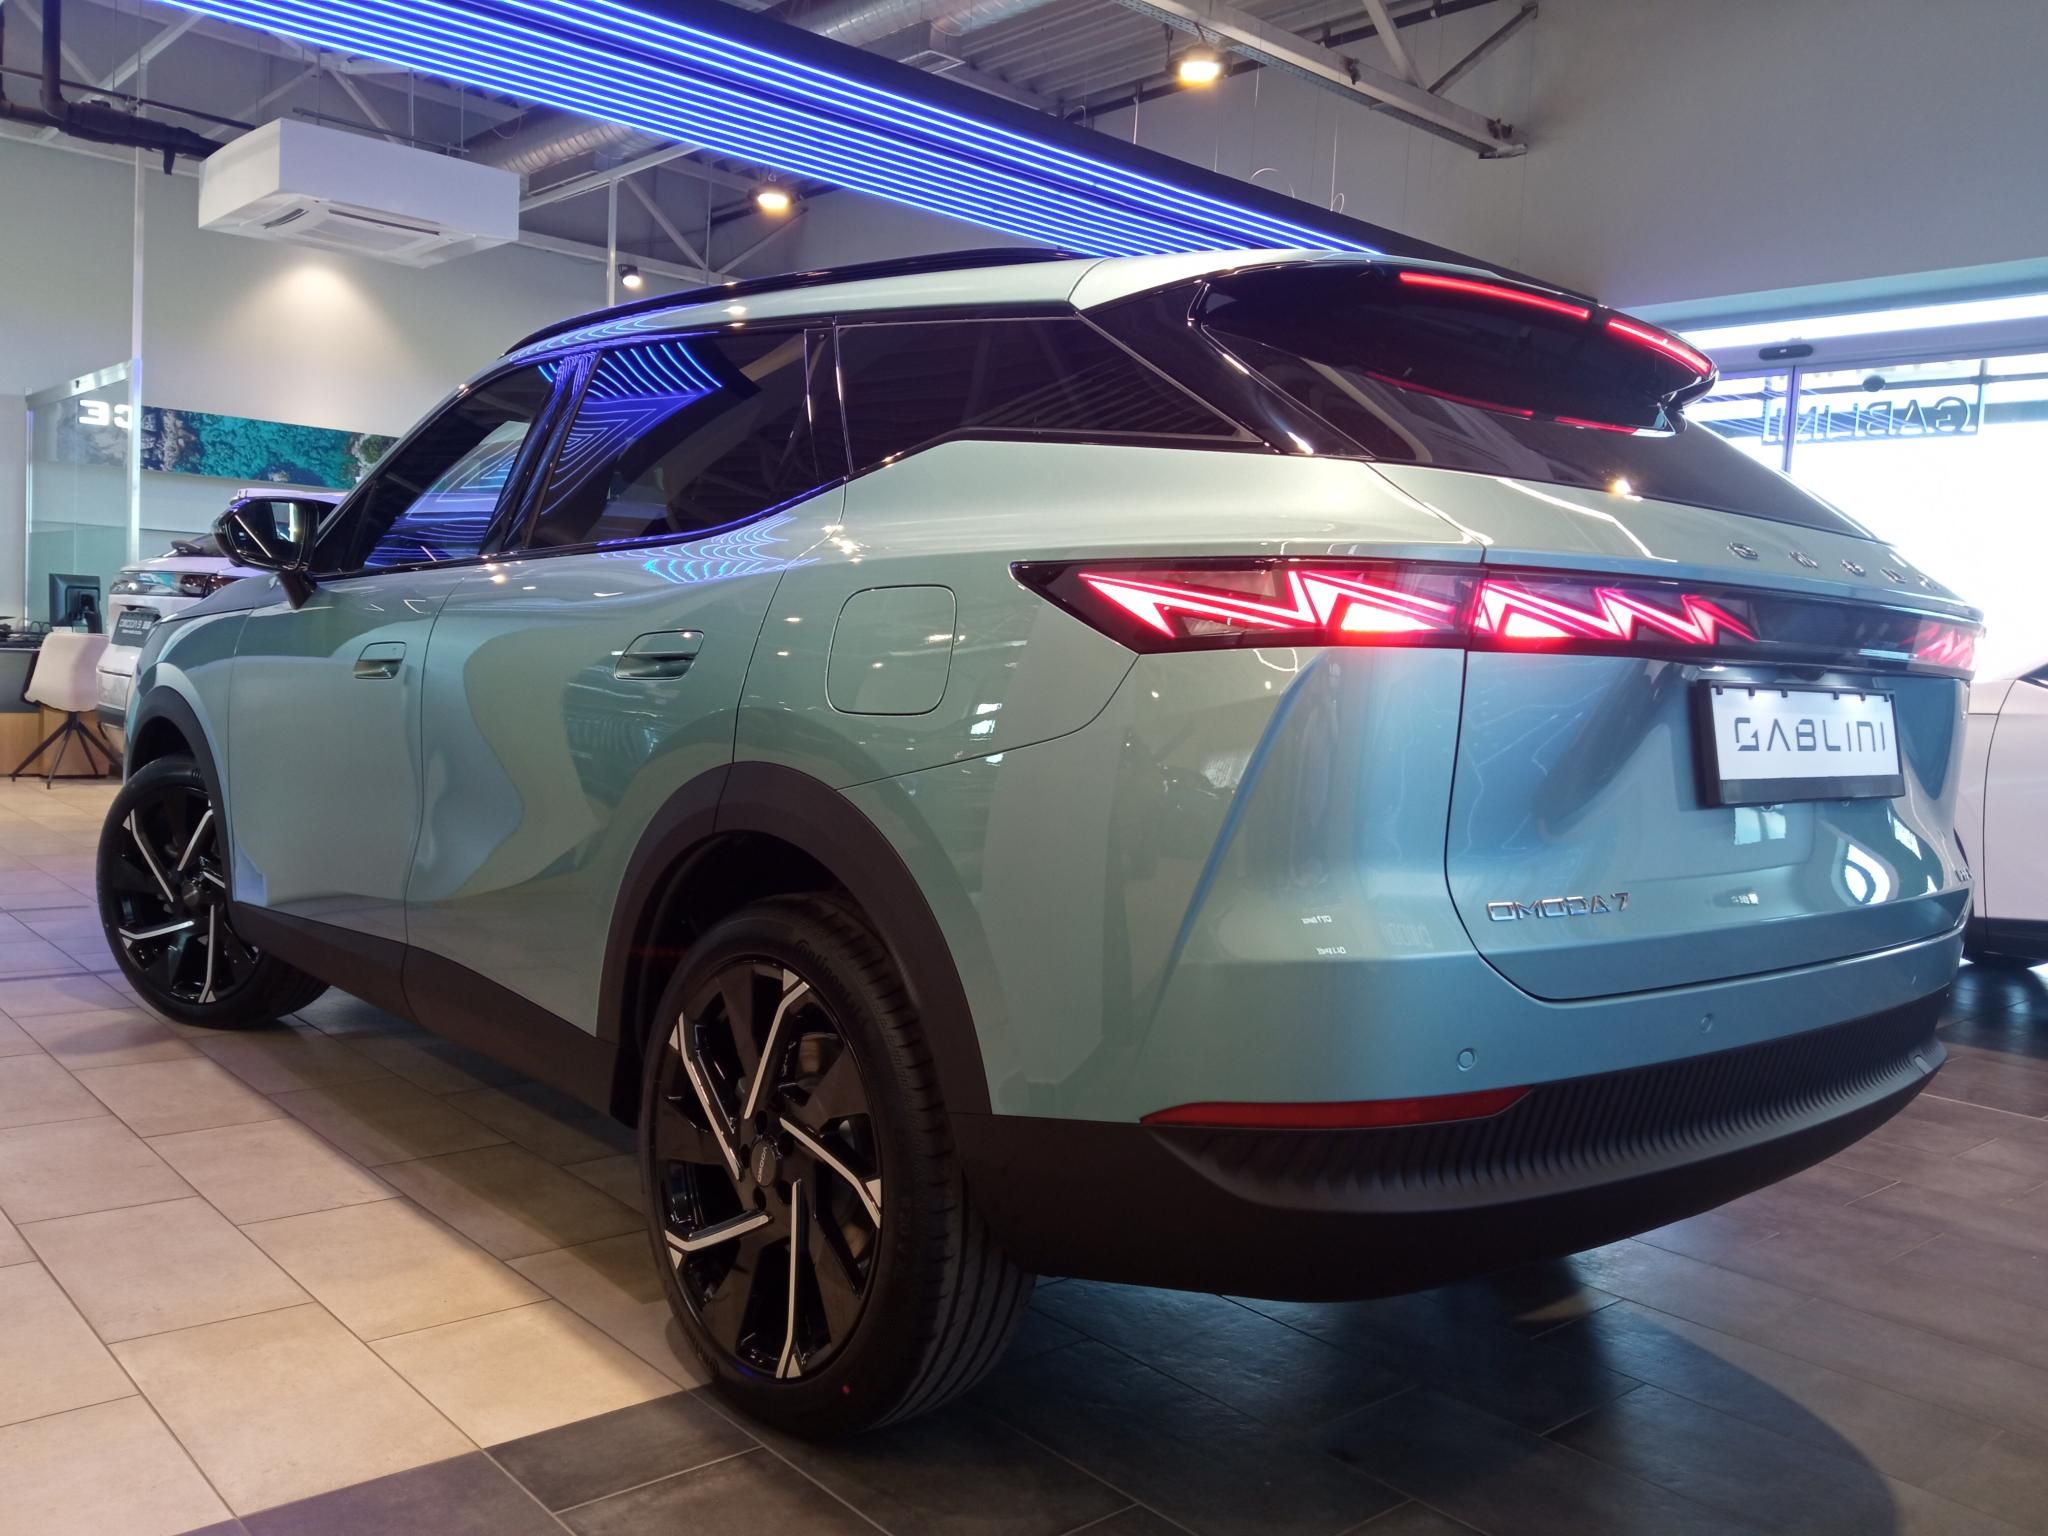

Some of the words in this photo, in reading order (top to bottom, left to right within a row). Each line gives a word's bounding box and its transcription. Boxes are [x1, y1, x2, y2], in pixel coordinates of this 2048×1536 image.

[1734, 716, 1886, 752] GABLINI
[1487, 895, 1611, 921] OMODA
[1611, 892, 1629, 911] 7
